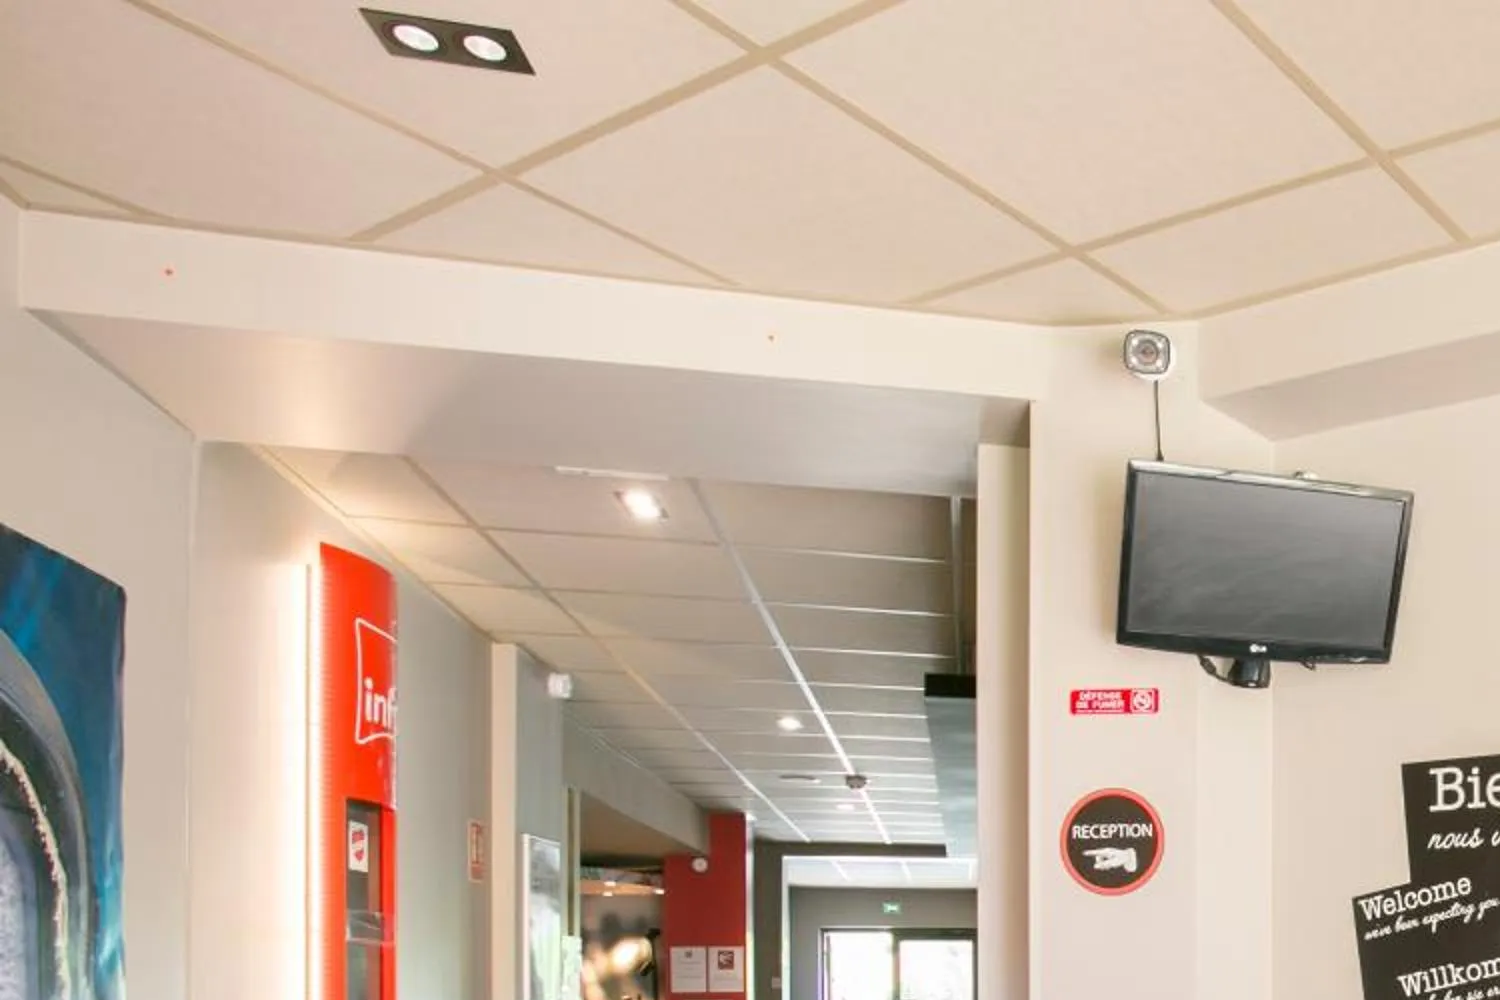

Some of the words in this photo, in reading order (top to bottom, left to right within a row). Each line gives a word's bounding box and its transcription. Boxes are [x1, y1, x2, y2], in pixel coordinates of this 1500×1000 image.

[1072, 823, 1153, 840] RECEPTION
[1427, 828, 1484, 849] nous
[1357, 877, 1472, 921] Welcome
